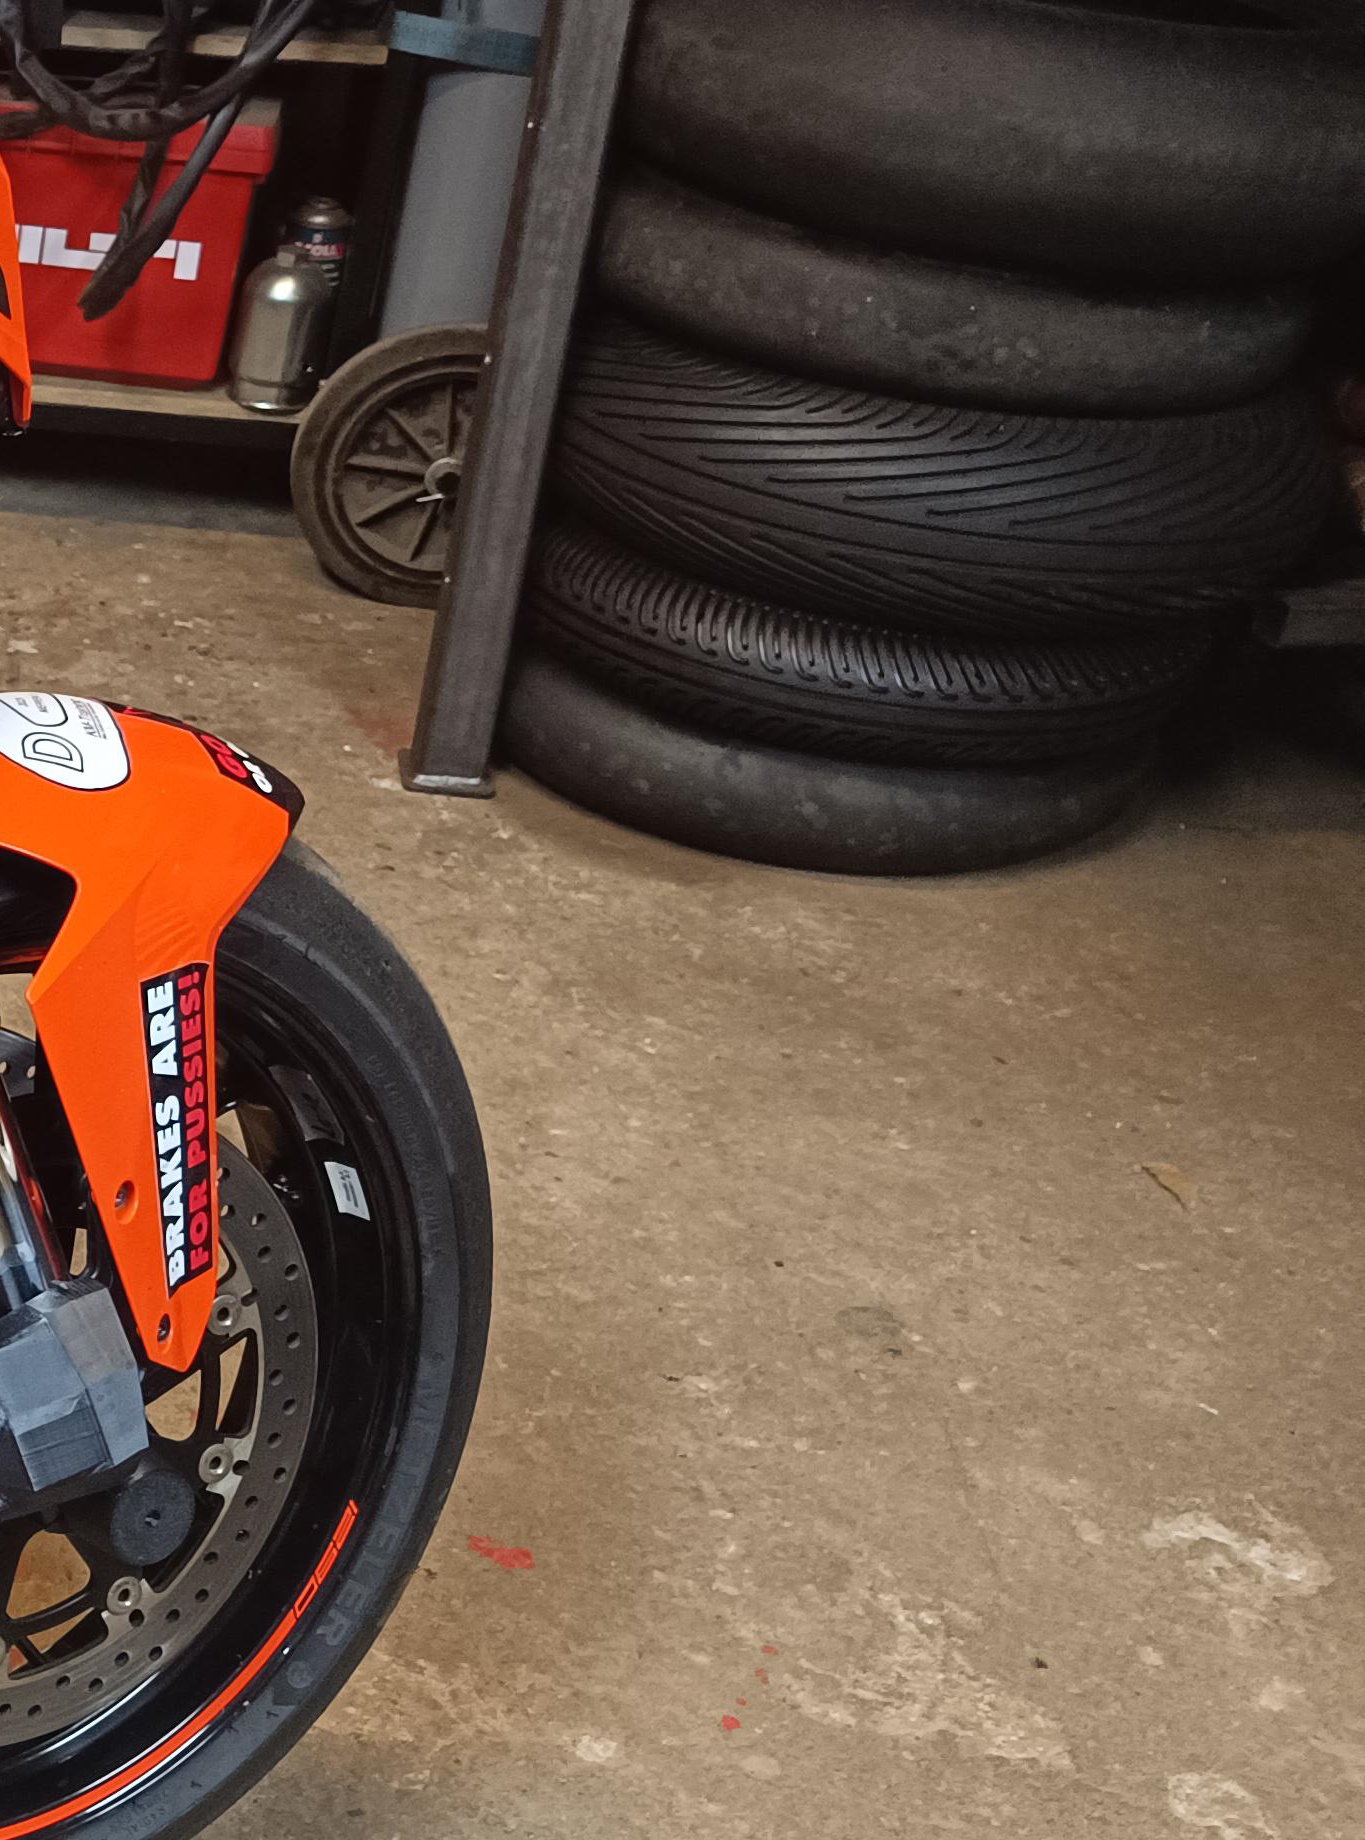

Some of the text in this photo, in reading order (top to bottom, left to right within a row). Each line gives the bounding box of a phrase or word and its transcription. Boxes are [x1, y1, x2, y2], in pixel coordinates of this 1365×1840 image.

[147, 980, 186, 1287] BRAKES ARE
[178, 970, 212, 1271] FOR PUSSIES!
